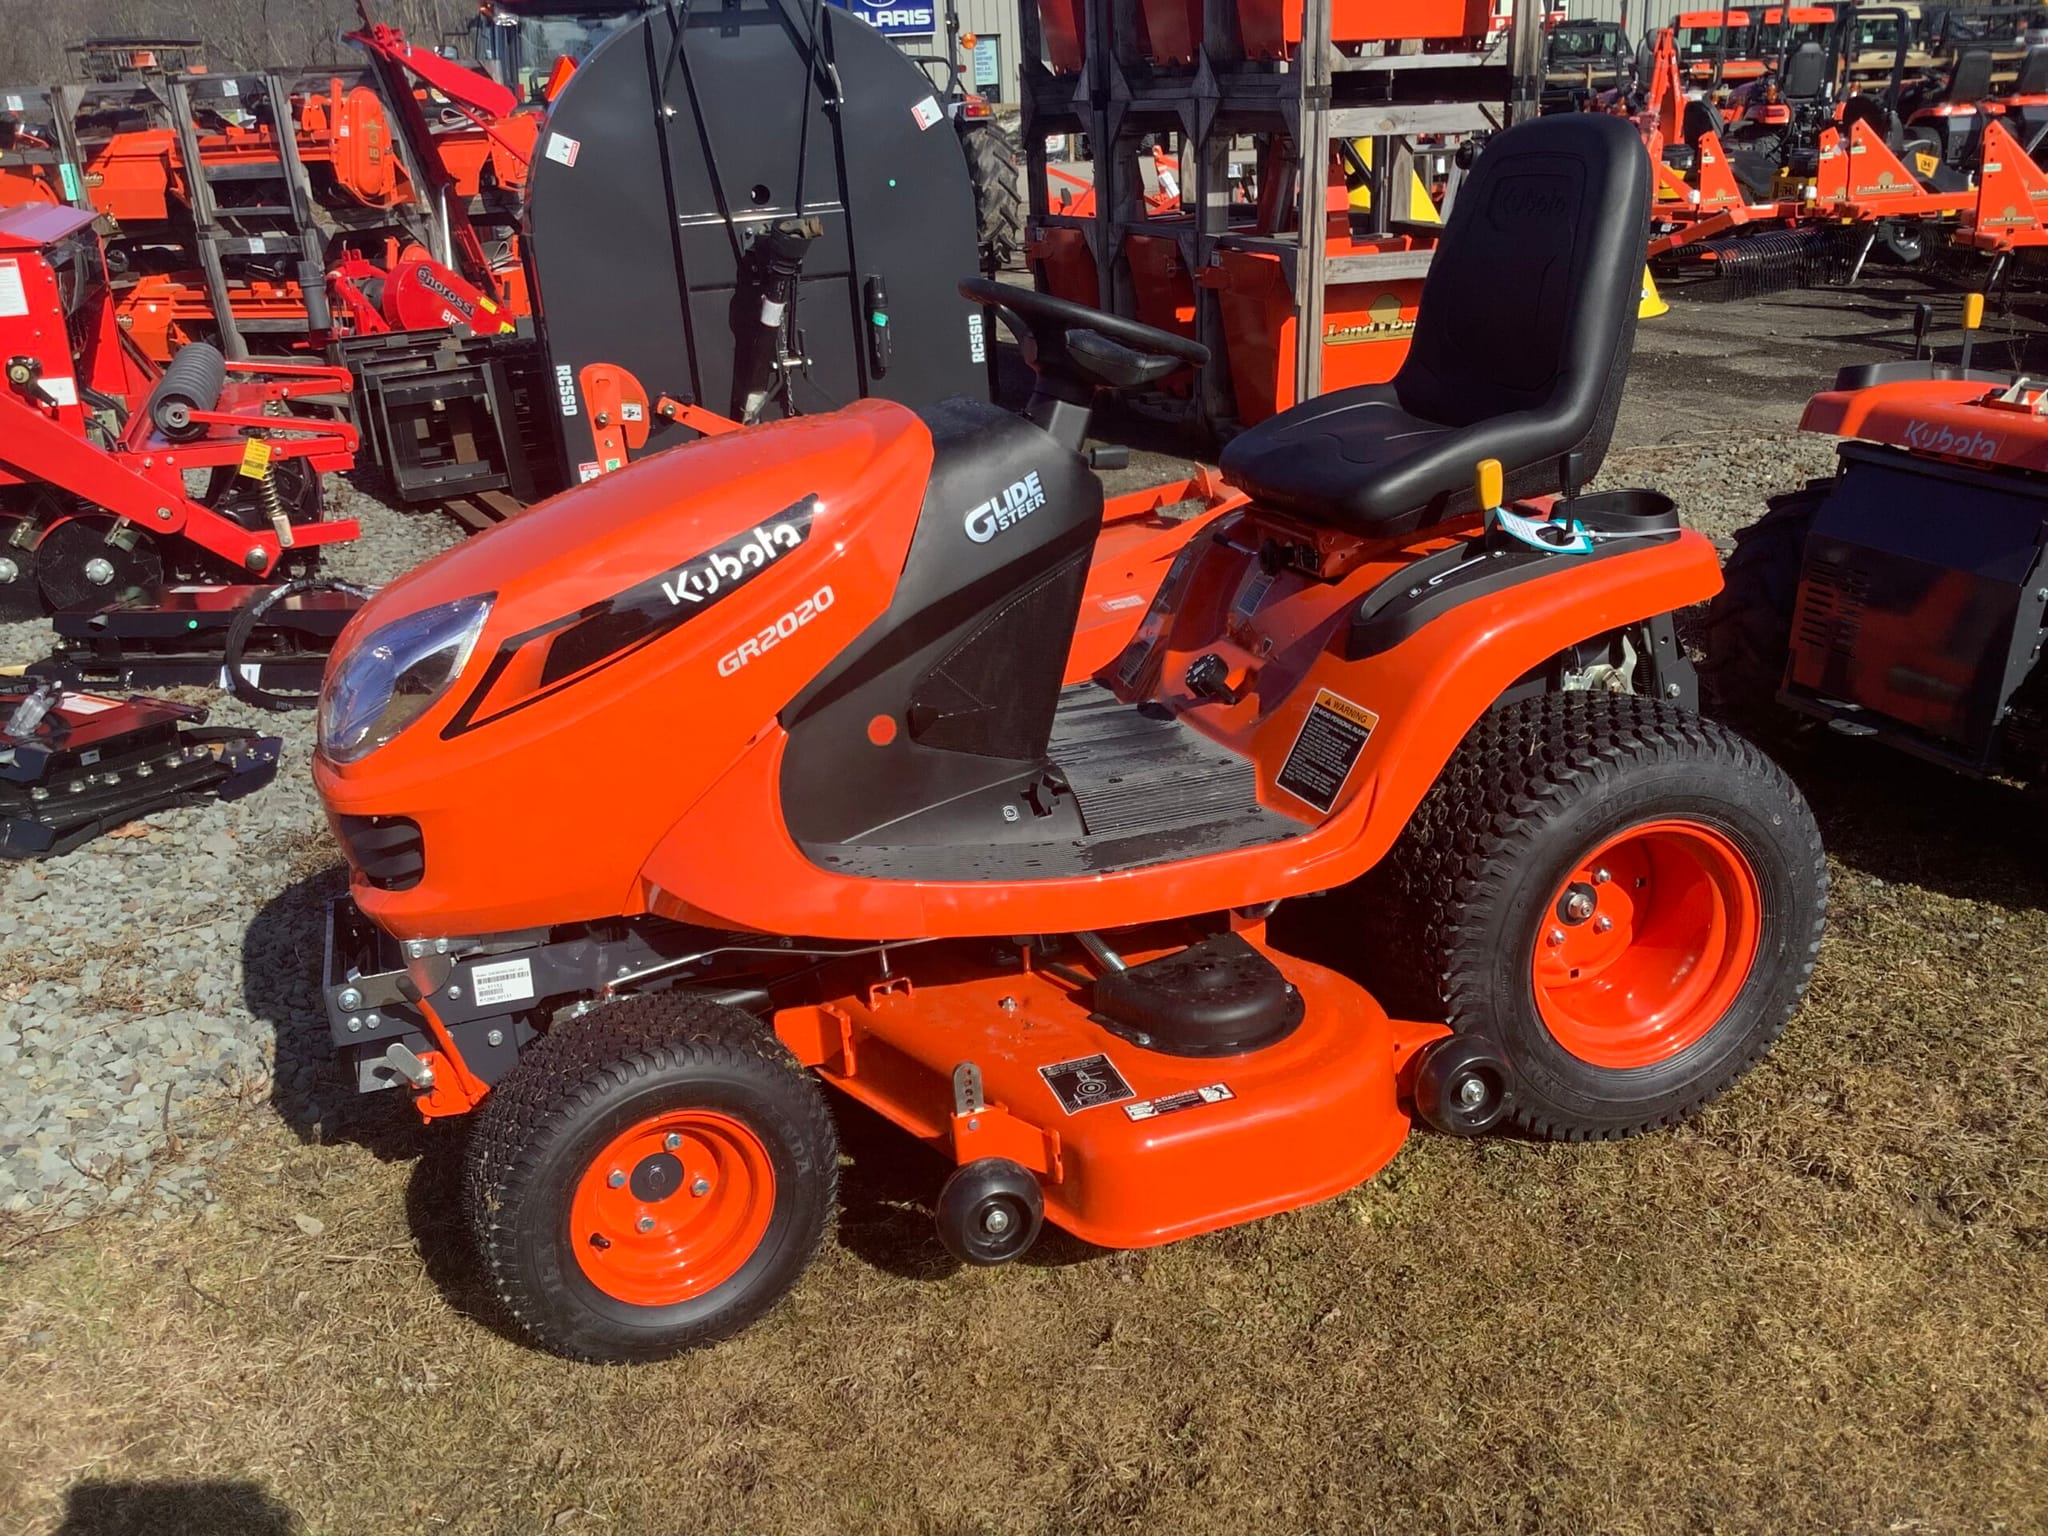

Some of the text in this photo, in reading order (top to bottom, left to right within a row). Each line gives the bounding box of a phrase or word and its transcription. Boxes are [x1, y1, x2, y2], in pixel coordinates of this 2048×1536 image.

[1904, 420, 1996, 460] Kubota
[965, 471, 1042, 543] GLIDE
[998, 493, 1046, 531] STEER
[662, 524, 802, 606] Kubota
[717, 585, 835, 677] GR2020
[1332, 700, 1368, 724] WARNING
